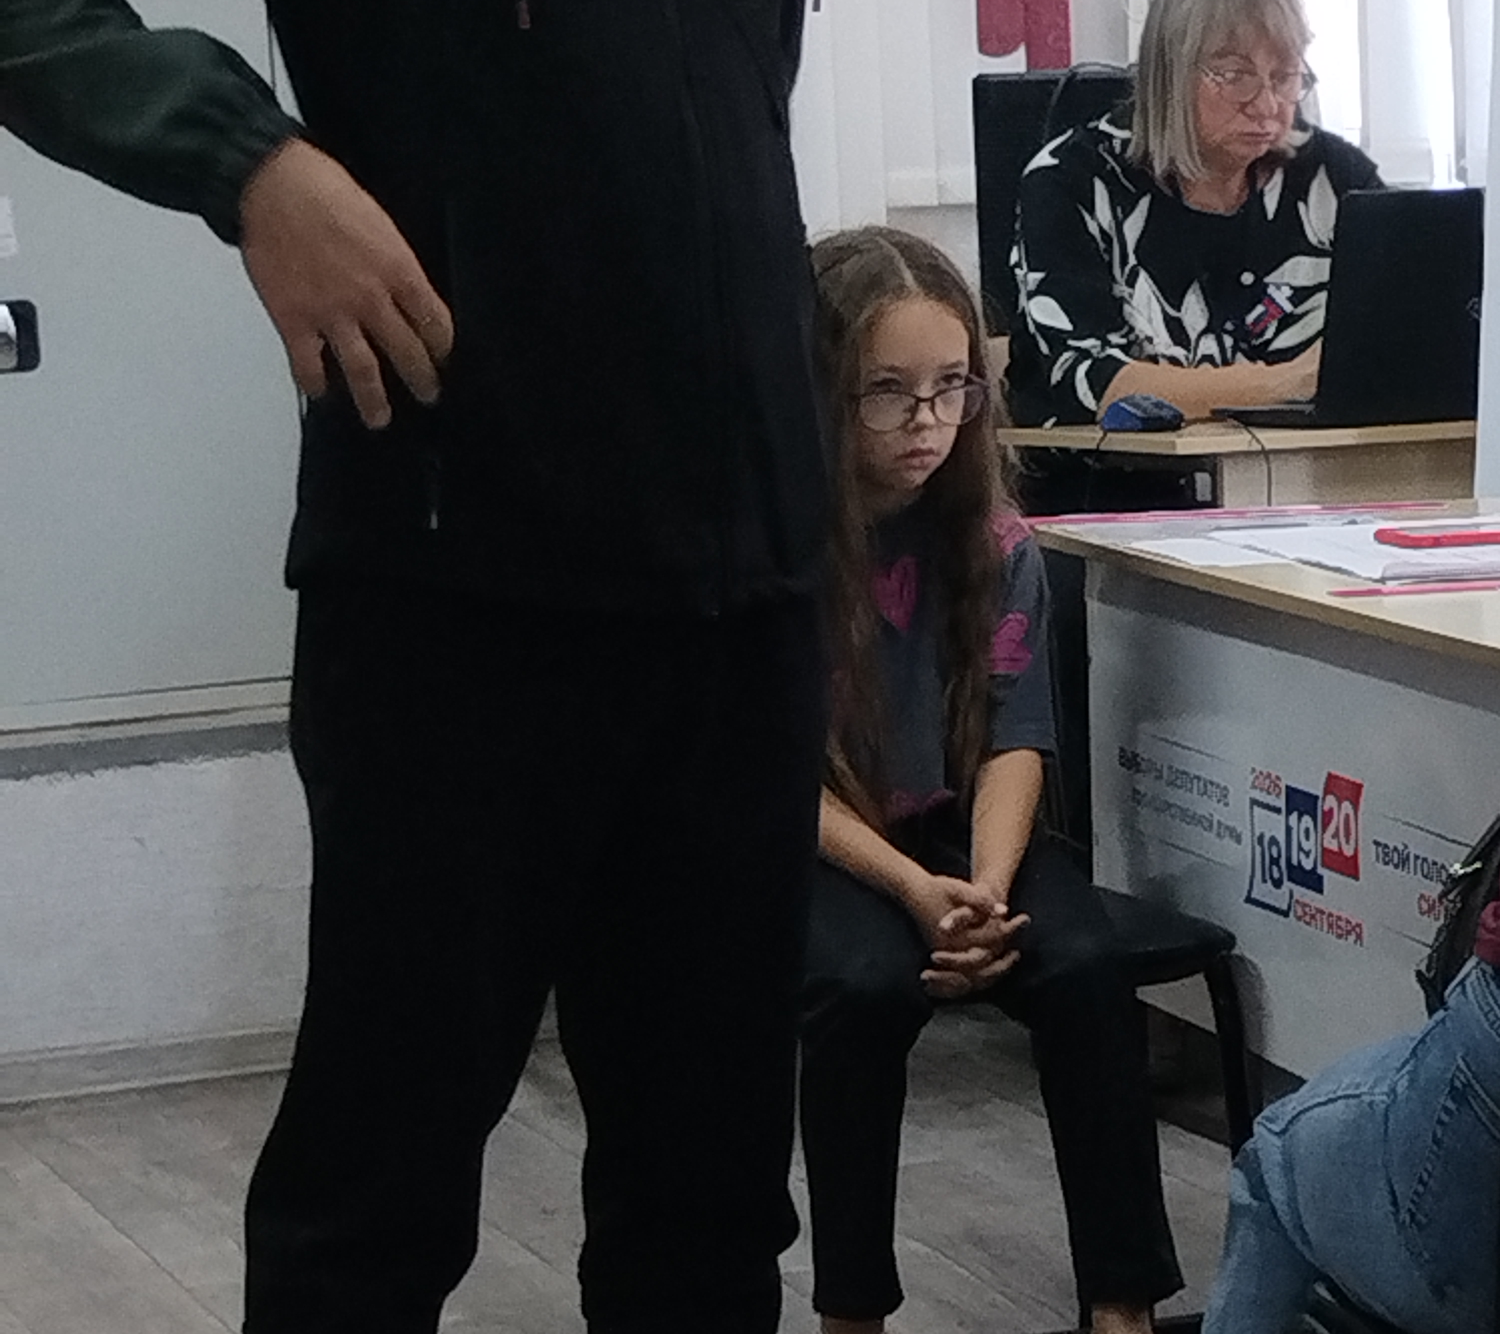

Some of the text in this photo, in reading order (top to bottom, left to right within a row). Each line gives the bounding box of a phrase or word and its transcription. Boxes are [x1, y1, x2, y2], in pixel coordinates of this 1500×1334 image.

[1288, 810, 1317, 871] 19
[1322, 793, 1357, 858] 20
[1256, 831, 1284, 890] 18
[1372, 839, 1451, 886] ТВОЙ ГОЛО
[1294, 898, 1364, 947] СЕНТЯБРЯ
